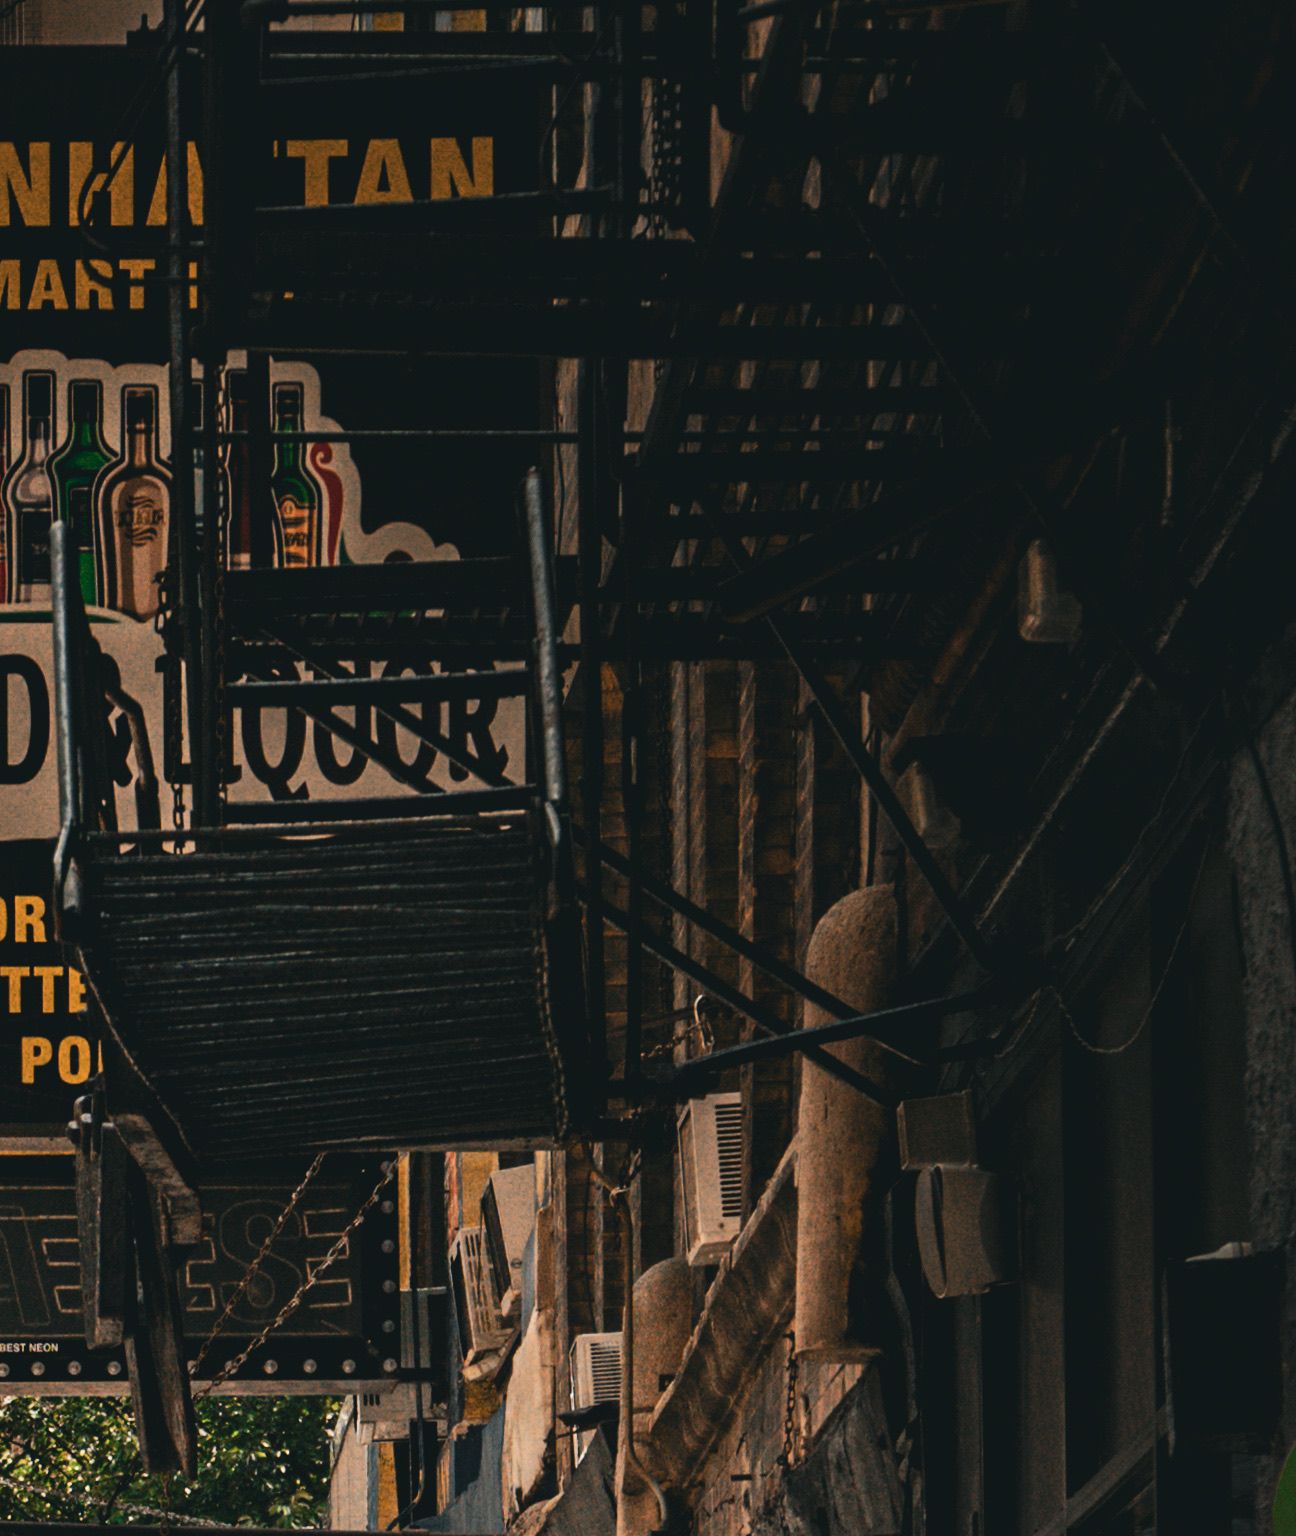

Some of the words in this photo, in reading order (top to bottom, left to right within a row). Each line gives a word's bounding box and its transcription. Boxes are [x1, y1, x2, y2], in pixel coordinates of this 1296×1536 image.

[21, 1036, 103, 1084] PO
[0, 1343, 26, 1353] BEST
[29, 1343, 59, 1353] NEON
